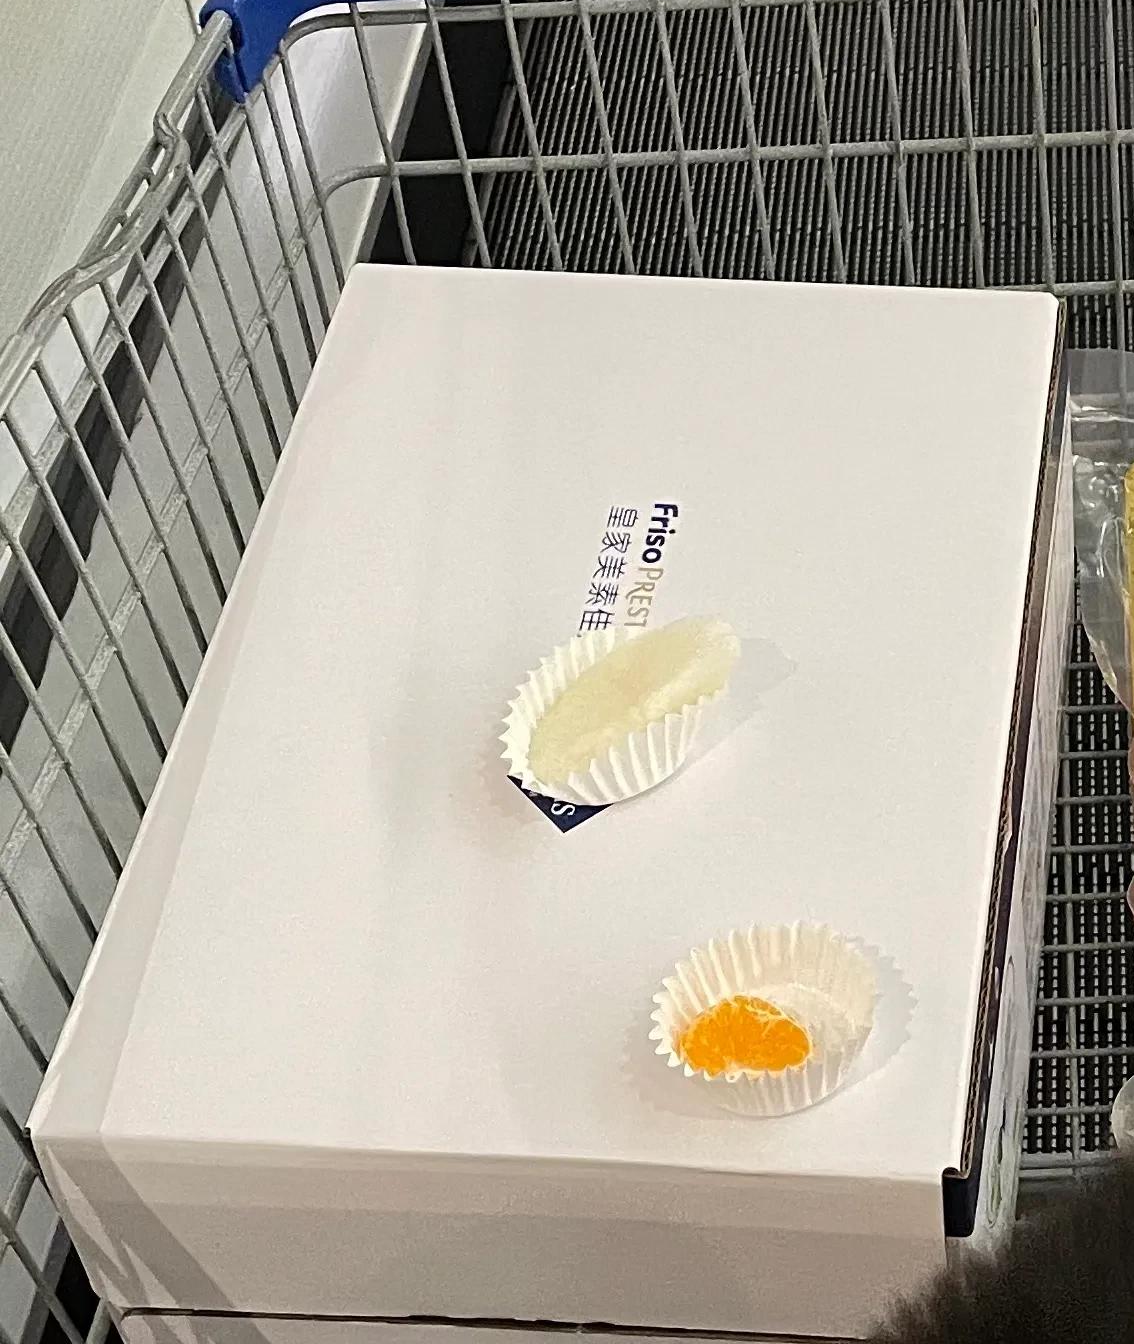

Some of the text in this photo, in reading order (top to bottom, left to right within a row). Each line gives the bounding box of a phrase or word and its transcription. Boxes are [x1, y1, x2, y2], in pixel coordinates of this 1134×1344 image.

[576, 506, 639, 637] 皇家美素佳
[641, 503, 679, 564] Friso
